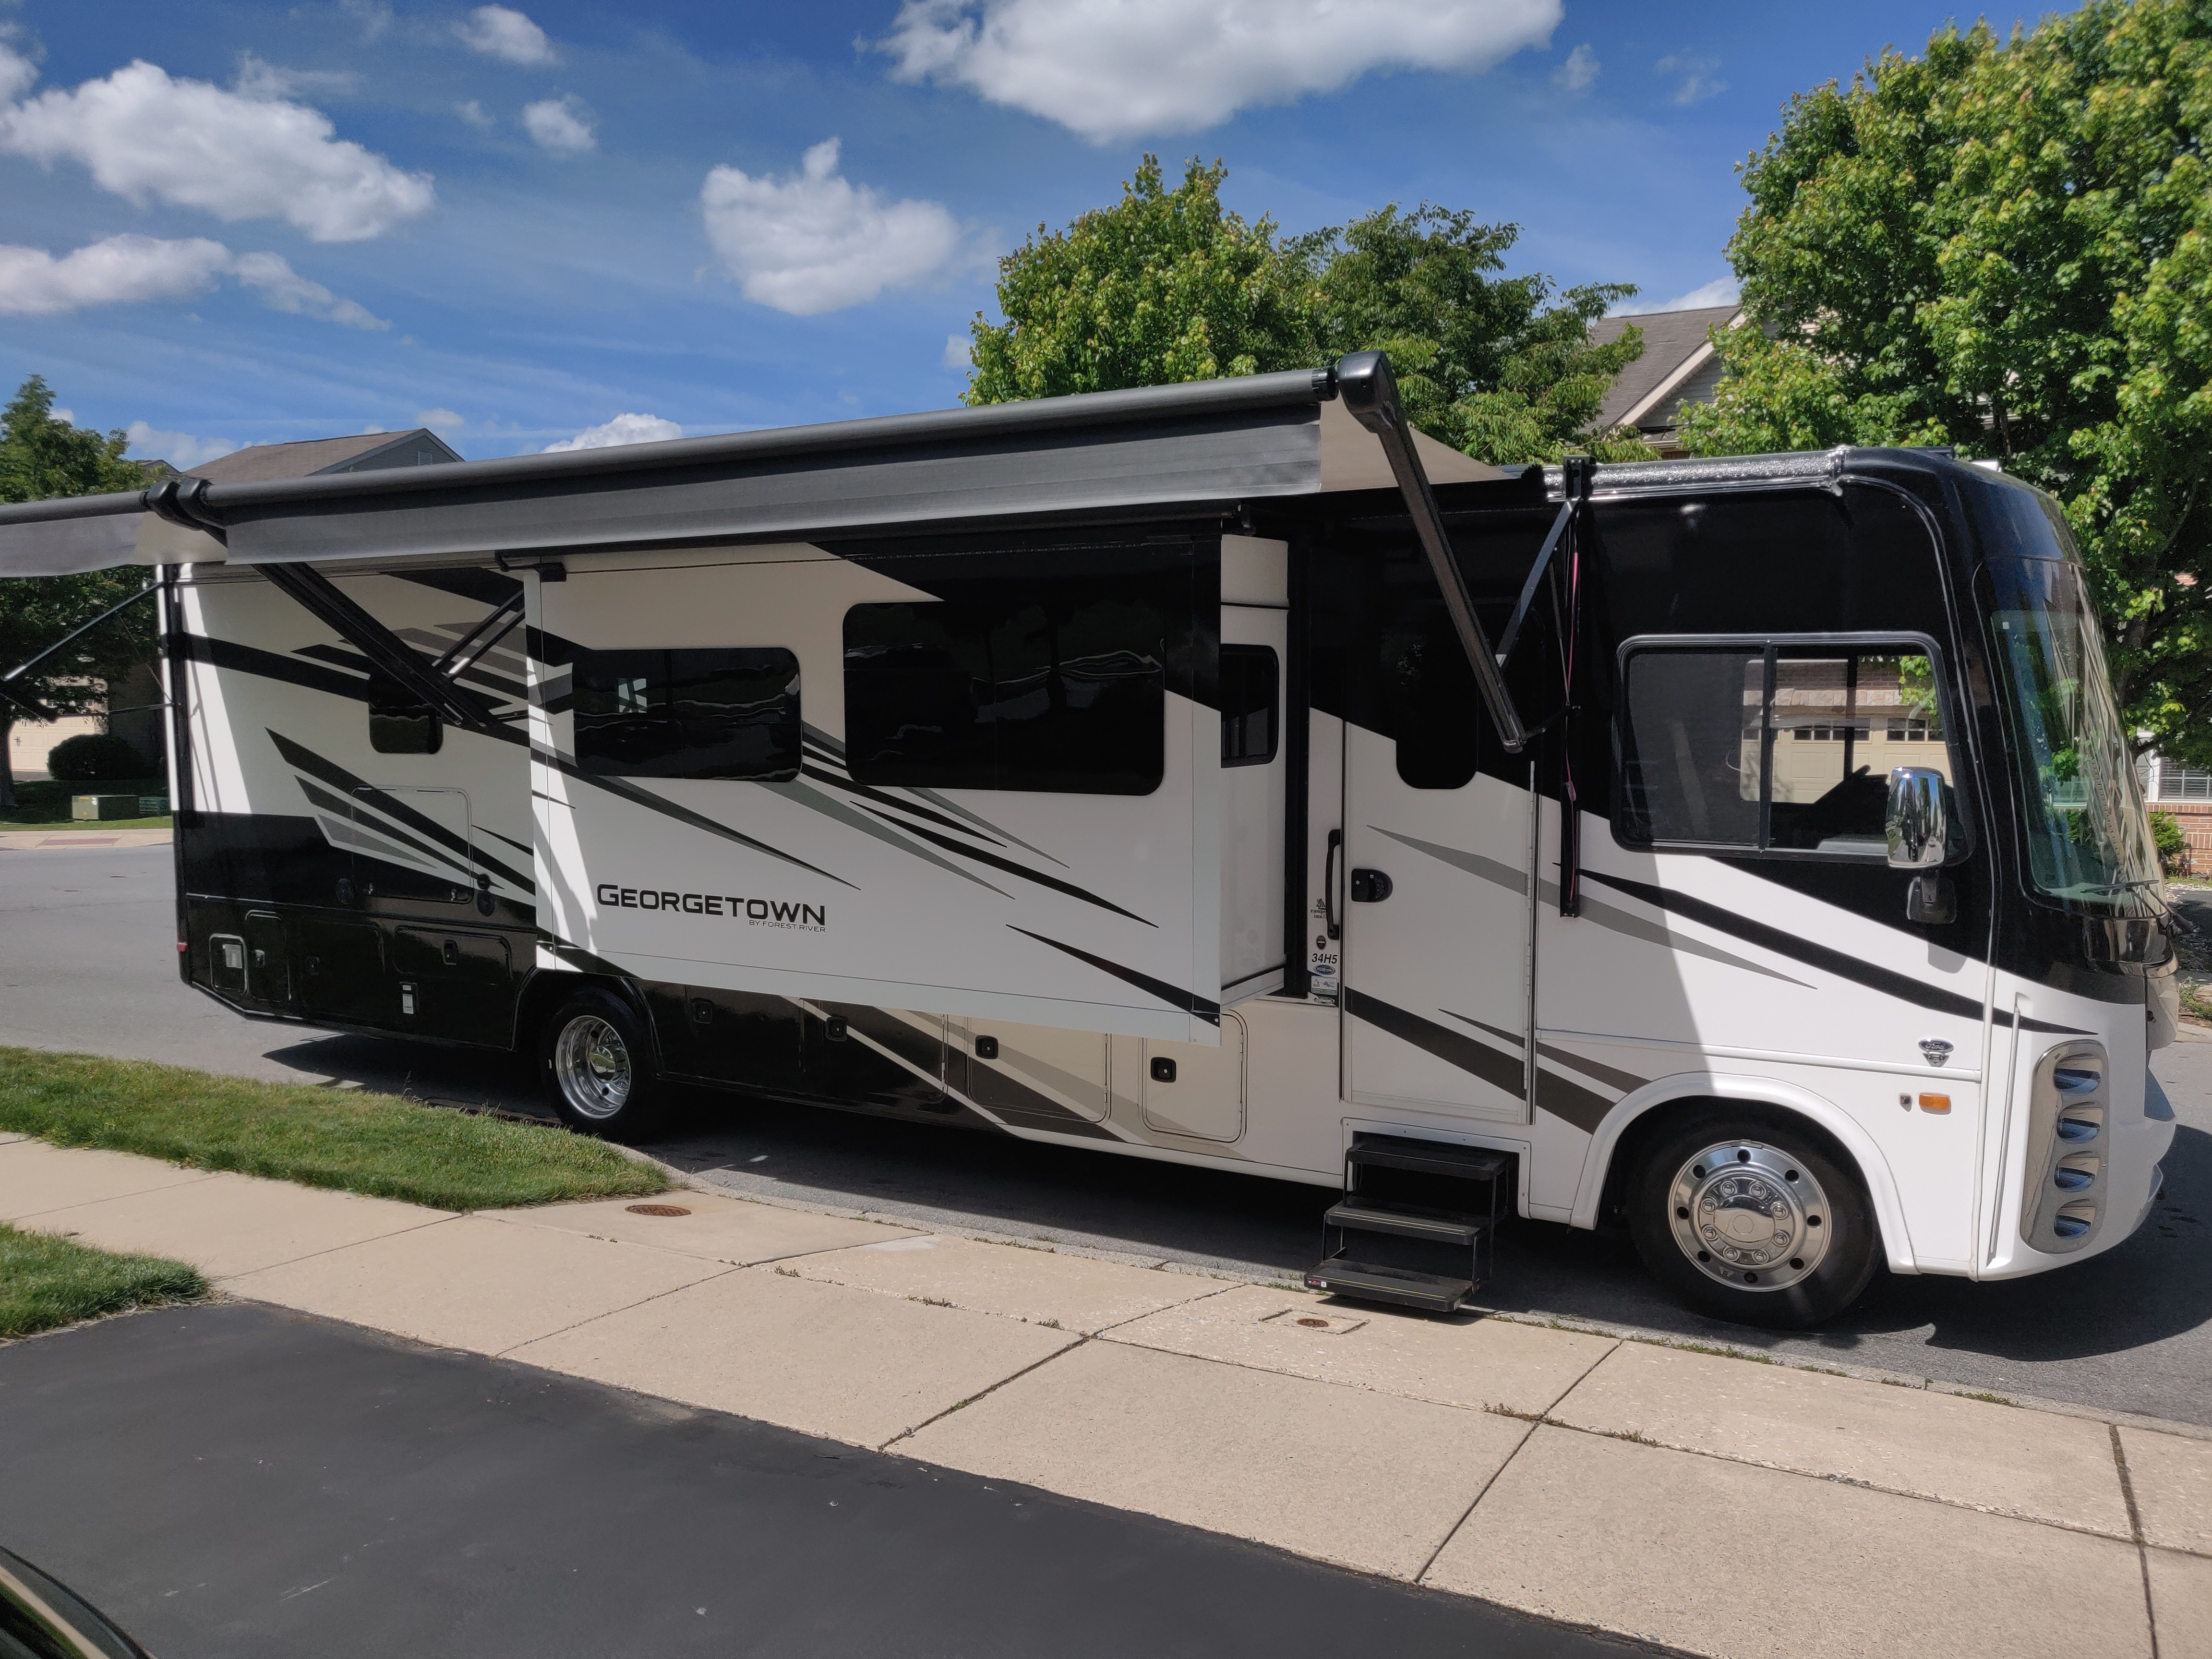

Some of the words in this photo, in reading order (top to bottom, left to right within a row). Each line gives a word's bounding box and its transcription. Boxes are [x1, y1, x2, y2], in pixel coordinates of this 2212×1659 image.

[597, 883, 826, 926] GEORGETOWN
[762, 921, 797, 930] FOREST
[799, 925, 826, 933] RIVER
[1311, 953, 1338, 964] 34H5
